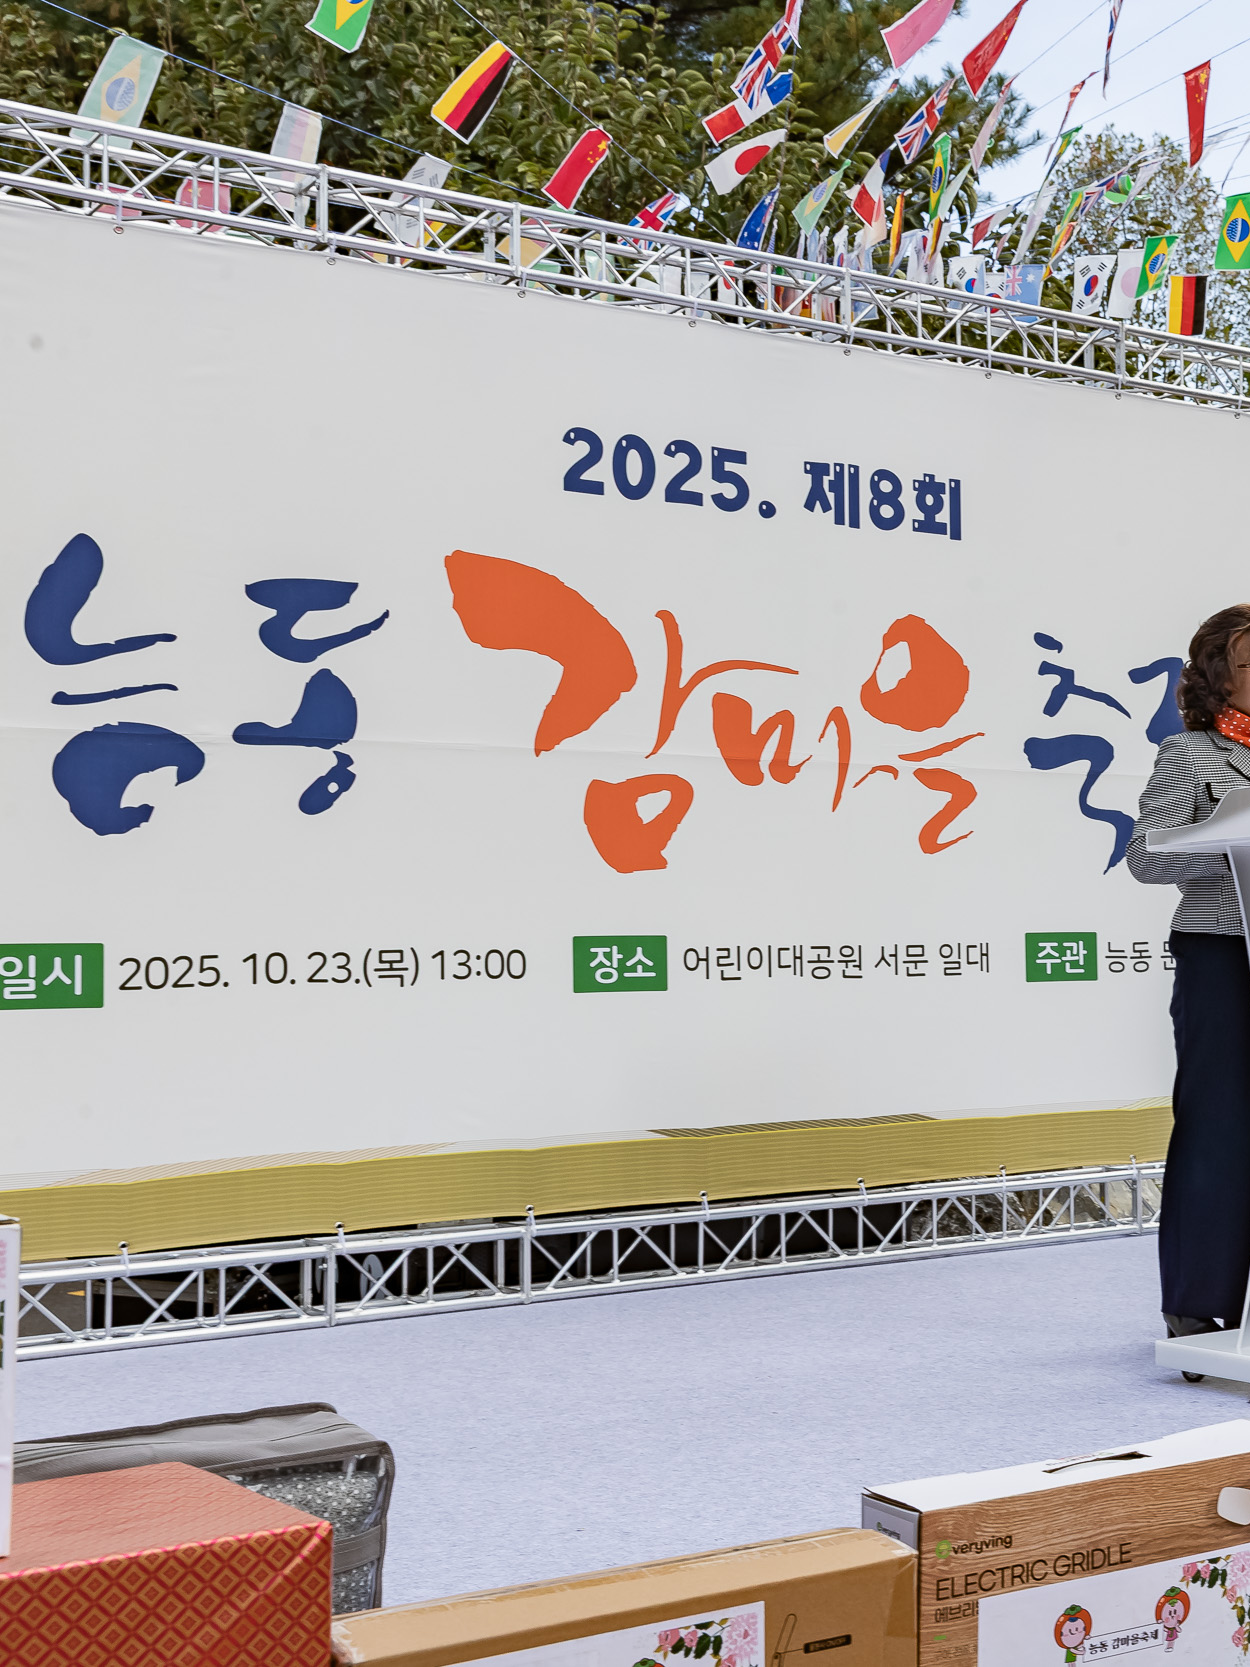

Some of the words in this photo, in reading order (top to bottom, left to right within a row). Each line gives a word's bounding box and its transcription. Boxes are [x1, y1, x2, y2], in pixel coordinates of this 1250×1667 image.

[562, 427, 776, 519] 2025.
[803, 461, 962, 541] 제8회
[24, 533, 389, 836] 능동
[444, 550, 985, 874] 감마을
[0, 955, 82, 999] 일시
[119, 955, 229, 990] 2025.
[242, 952, 296, 985] 10.
[307, 947, 419, 988] 23.(목)
[431, 949, 526, 980] 13:00
[590, 946, 656, 984] 장소
[683, 945, 863, 981] 어린이대공원
[874, 944, 928, 977] 서문
[939, 943, 989, 976] 일대
[1035, 941, 1087, 974] 주관
[1105, 942, 1152, 973] 능동
[936, 1559, 1048, 1601] ELECTRIC
[1053, 1542, 1132, 1577] GRIDLE
[1088, 1639, 1109, 1655] 능동
